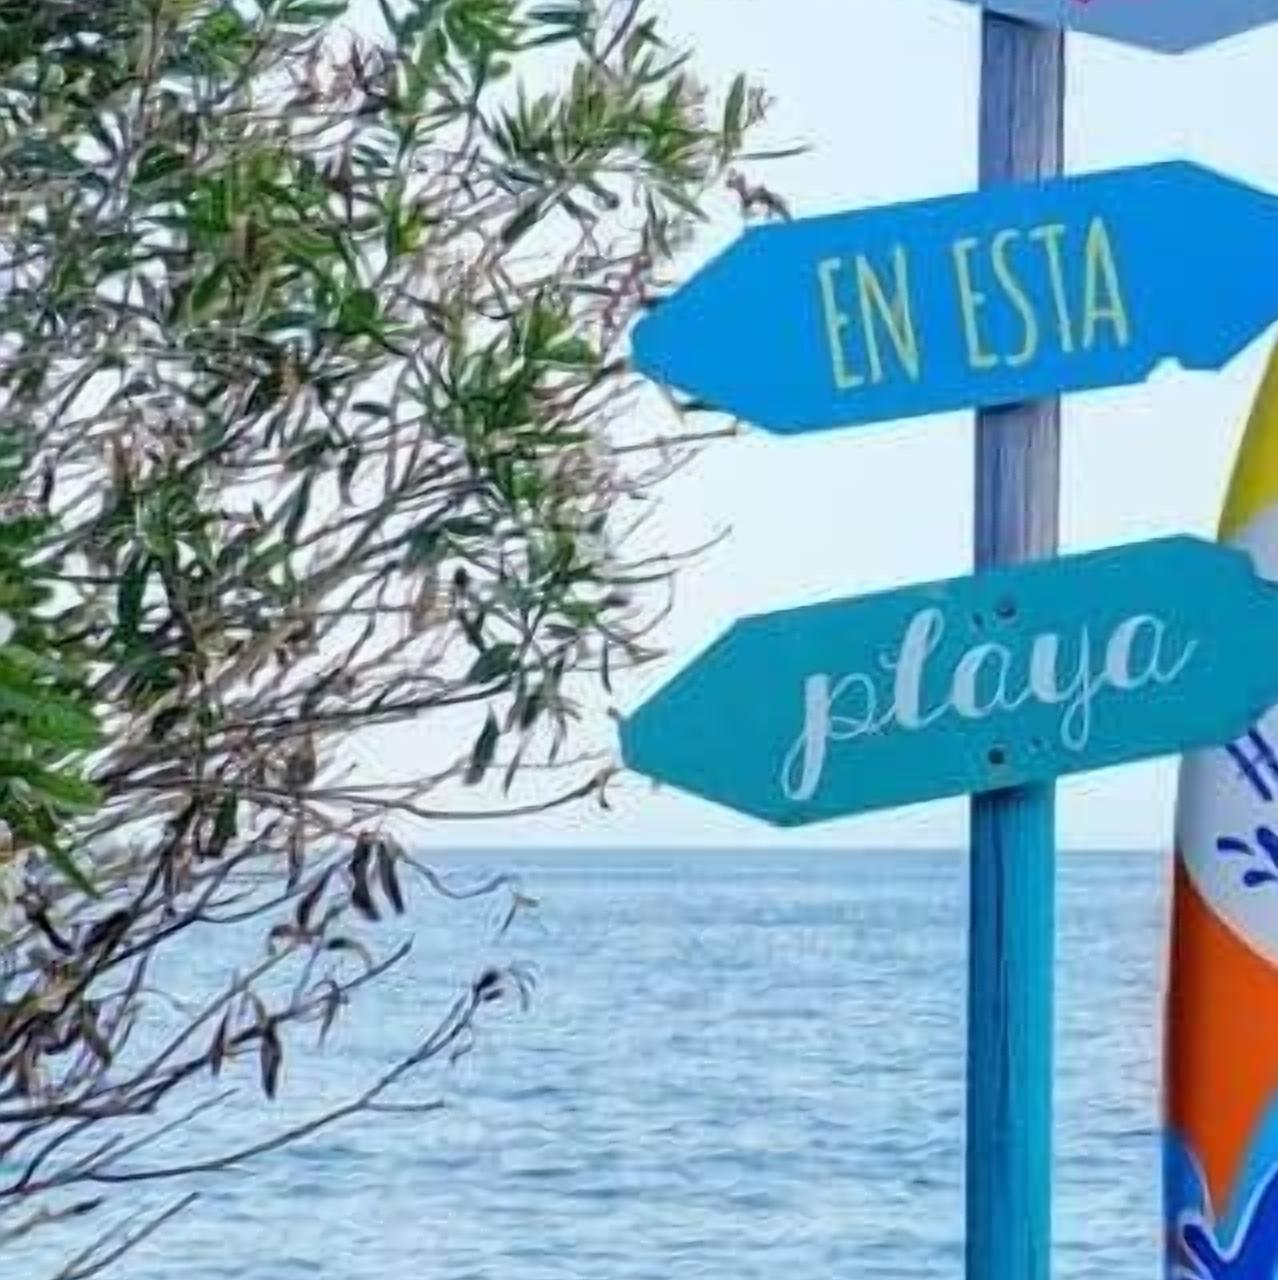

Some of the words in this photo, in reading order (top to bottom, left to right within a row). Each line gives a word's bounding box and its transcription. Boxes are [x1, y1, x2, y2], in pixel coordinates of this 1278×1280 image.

[818, 245, 920, 390] EN
[952, 216, 1131, 368] ESTA
[781, 607, 1197, 801] playa
